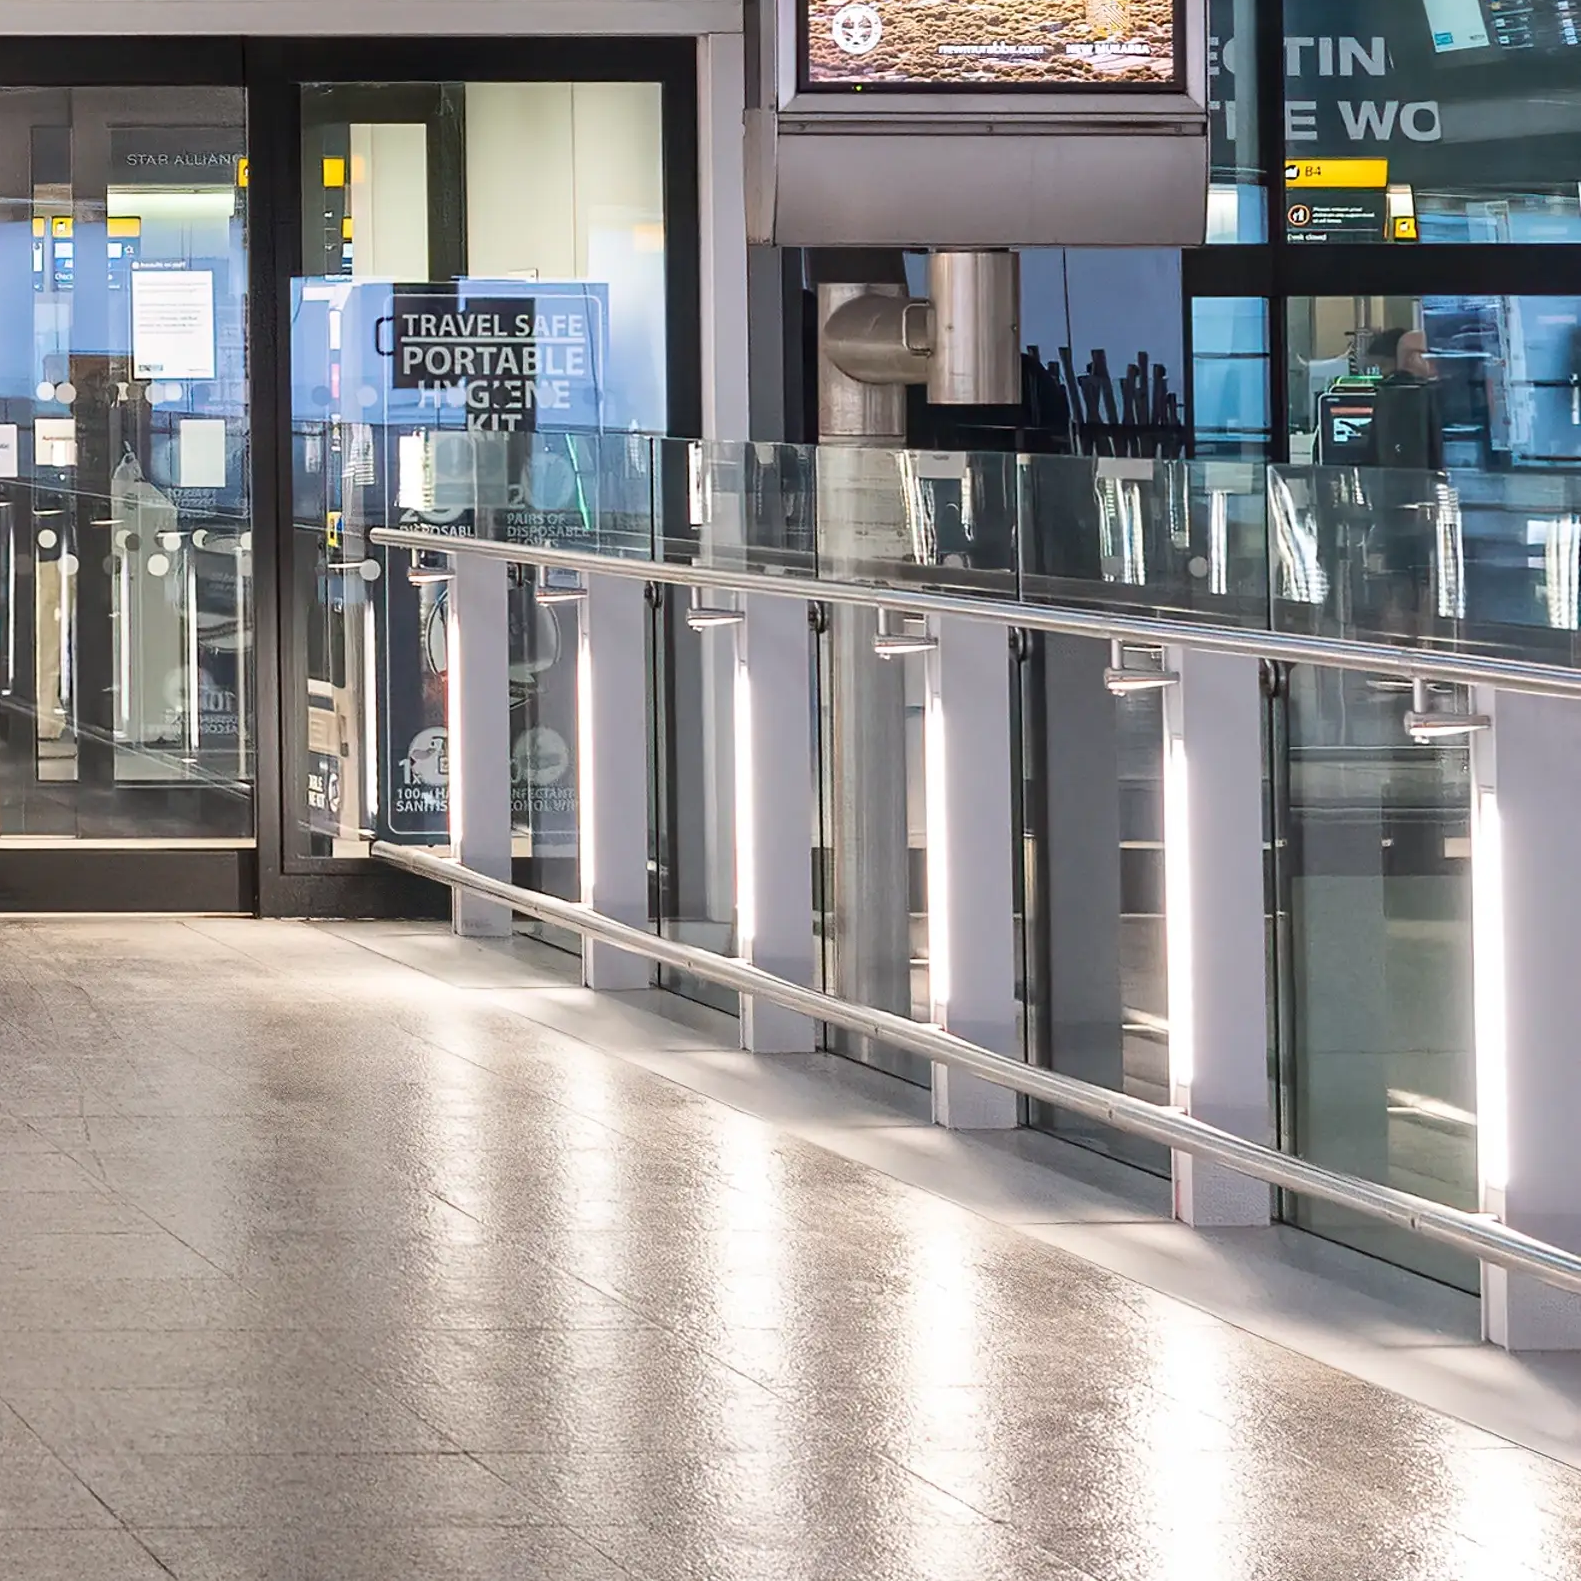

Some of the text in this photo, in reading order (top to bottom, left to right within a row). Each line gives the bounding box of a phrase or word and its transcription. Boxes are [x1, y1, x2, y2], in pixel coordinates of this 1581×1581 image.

[174, 153, 243, 167] ALLIANC
[1304, 165, 1322, 177] B4
[402, 314, 584, 337] TRAVEL SAFE
[402, 346, 585, 376] PORTABLE
